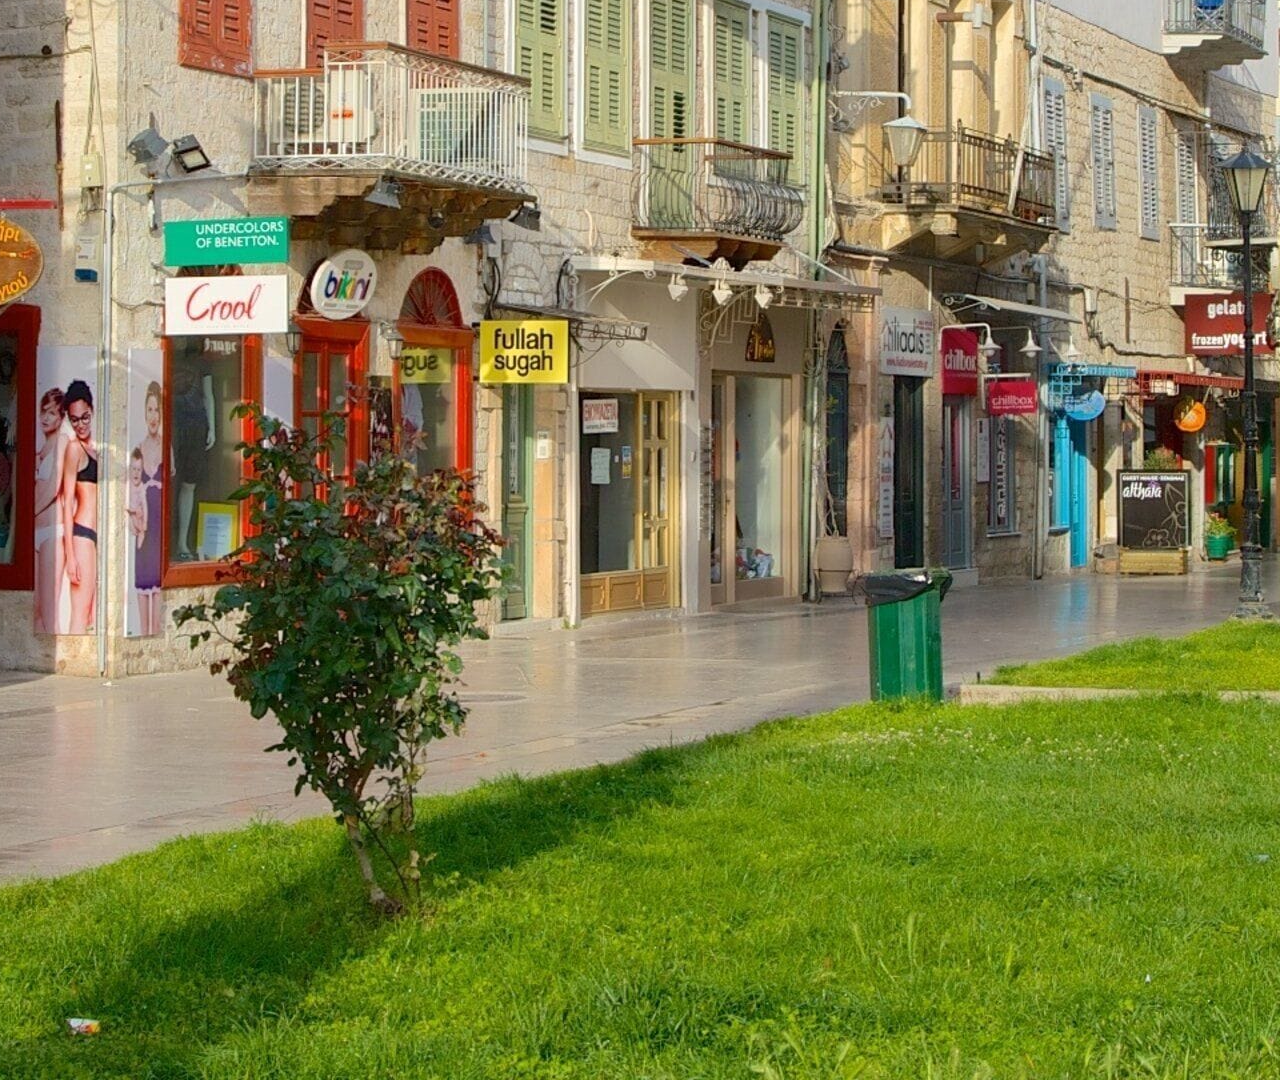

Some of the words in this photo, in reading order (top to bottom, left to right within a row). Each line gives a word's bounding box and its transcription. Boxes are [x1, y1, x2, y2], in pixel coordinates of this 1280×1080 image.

[195, 220, 284, 235] UNDERCOLORS
[195, 237, 212, 249] OF
[324, 270, 373, 300] bikini
[186, 282, 262, 321] Crool
[494, 328, 554, 350] fullah
[494, 351, 554, 377] sugah
[944, 348, 977, 371] chillbox
